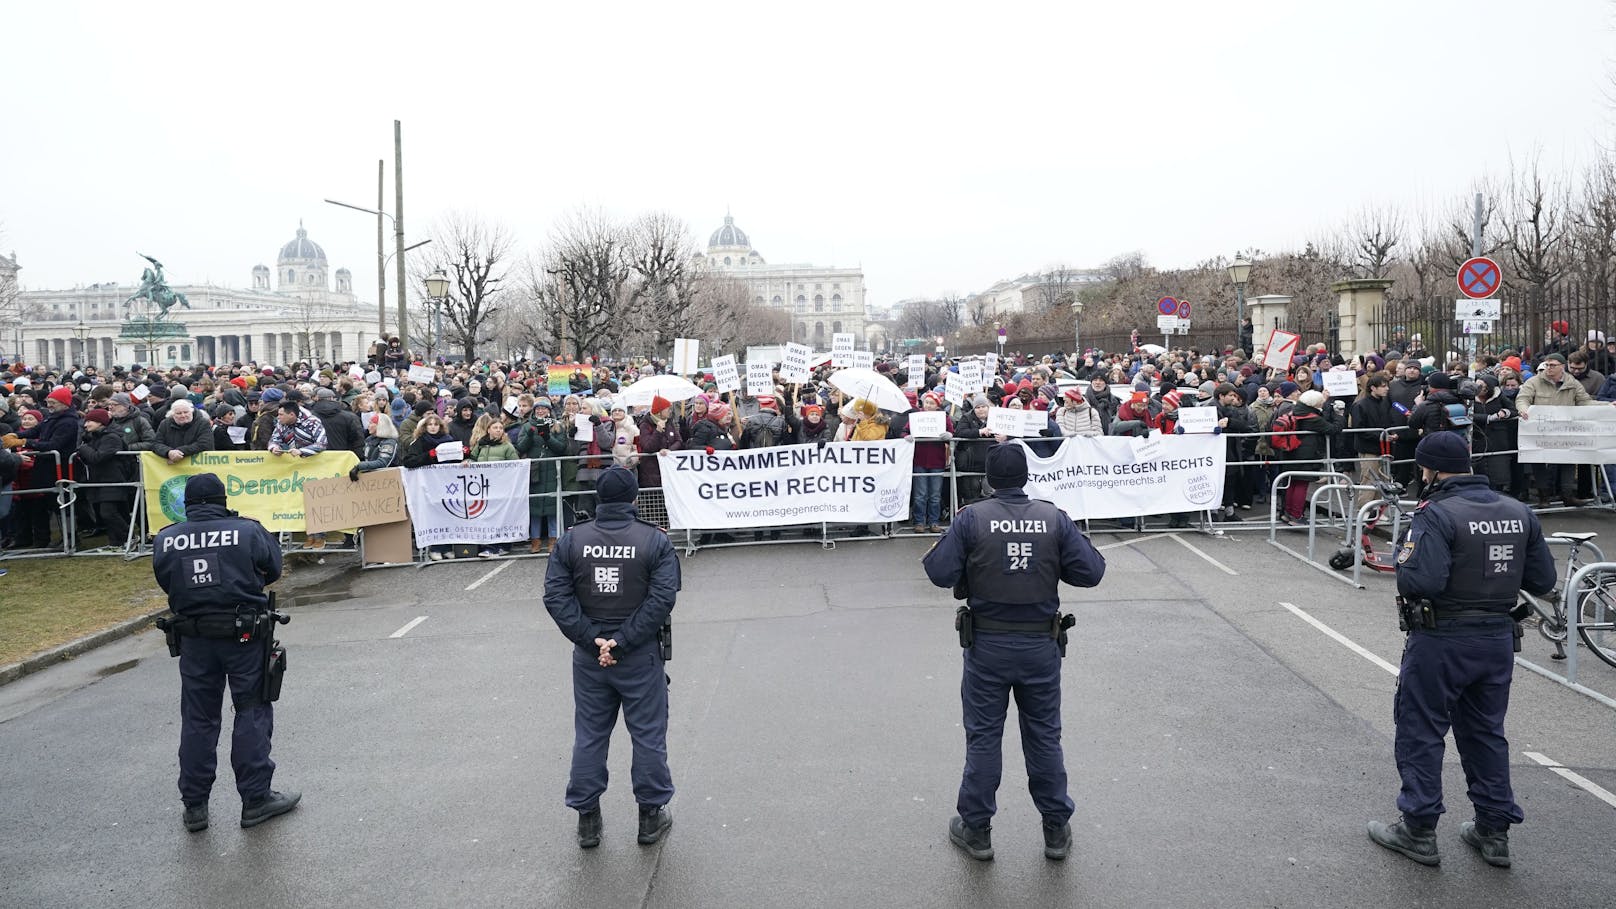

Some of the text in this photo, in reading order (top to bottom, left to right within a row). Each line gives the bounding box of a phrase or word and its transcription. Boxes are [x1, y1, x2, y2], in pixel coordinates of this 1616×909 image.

[789, 347, 806, 356] OMAS
[716, 359, 731, 368] OMAS
[786, 355, 806, 364] GEGEN
[717, 368, 734, 376] GEGEN
[782, 364, 805, 373] RECHTS
[717, 376, 738, 385] RECHTS
[190, 452, 264, 465] Klima braucht
[676, 447, 896, 472] ZUSAMMENHALTEN
[1112, 461, 1157, 475] GEGEN
[1161, 456, 1214, 471] RECHTS
[1054, 474, 1167, 491] www.oasgegenrechts.at
[1187, 475, 1208, 484] OMAS
[307, 478, 400, 500] VOLKKANZLER!
[698, 475, 876, 500] GEGEN RECHTS
[1188, 483, 1210, 492] GEGEN
[1190, 489, 1214, 500] RECHTS
[879, 496, 899, 504] GEGEN
[879, 502, 901, 512] RECHTS
[351, 496, 401, 519] DANKE!
[726, 503, 849, 518] www.omasgegenrechts.at
[990, 519, 1047, 533] POLIZEI
[1468, 519, 1524, 535] POLIZEI
[163, 530, 239, 552] POLIZEI
[583, 545, 636, 559] POLIZEI
[1007, 542, 1032, 557] BE
[1489, 544, 1514, 561] BE
[193, 558, 208, 574] D
[1009, 556, 1028, 570] 24
[1494, 562, 1508, 573] 24
[191, 573, 213, 584] 151
[594, 566, 619, 582] BE
[597, 583, 617, 593] 120
